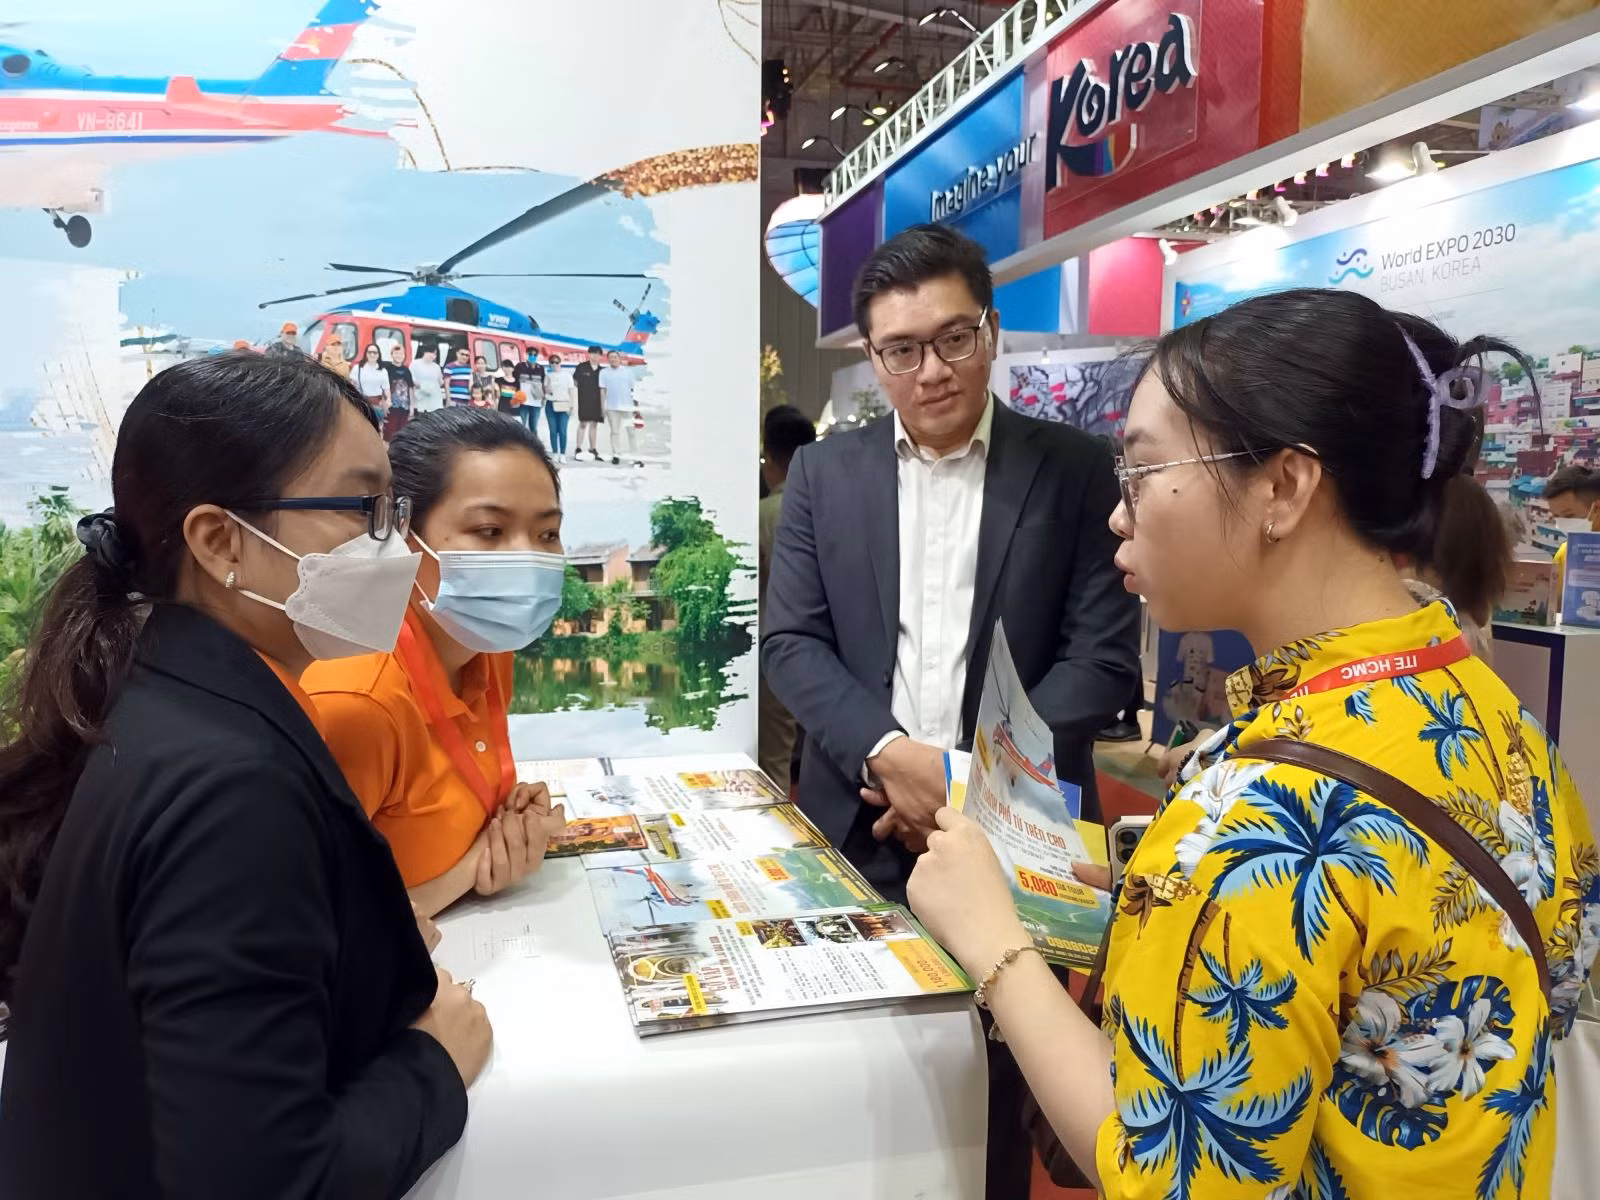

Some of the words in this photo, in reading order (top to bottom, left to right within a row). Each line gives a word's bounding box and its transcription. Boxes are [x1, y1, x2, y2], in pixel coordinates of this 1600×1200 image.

[1046, 13, 1197, 193] Korea
[77, 111, 143, 131] VN-8641
[995, 131, 1037, 193] your
[1381, 244, 1422, 270] World
[1426, 234, 1469, 261] EXPO
[1472, 223, 1516, 249] 2030
[1432, 255, 1481, 280] KOREA
[1341, 658, 1391, 680] HCMC
[1394, 655, 1417, 670] ITE
[1018, 870, 1058, 897] 5,080
